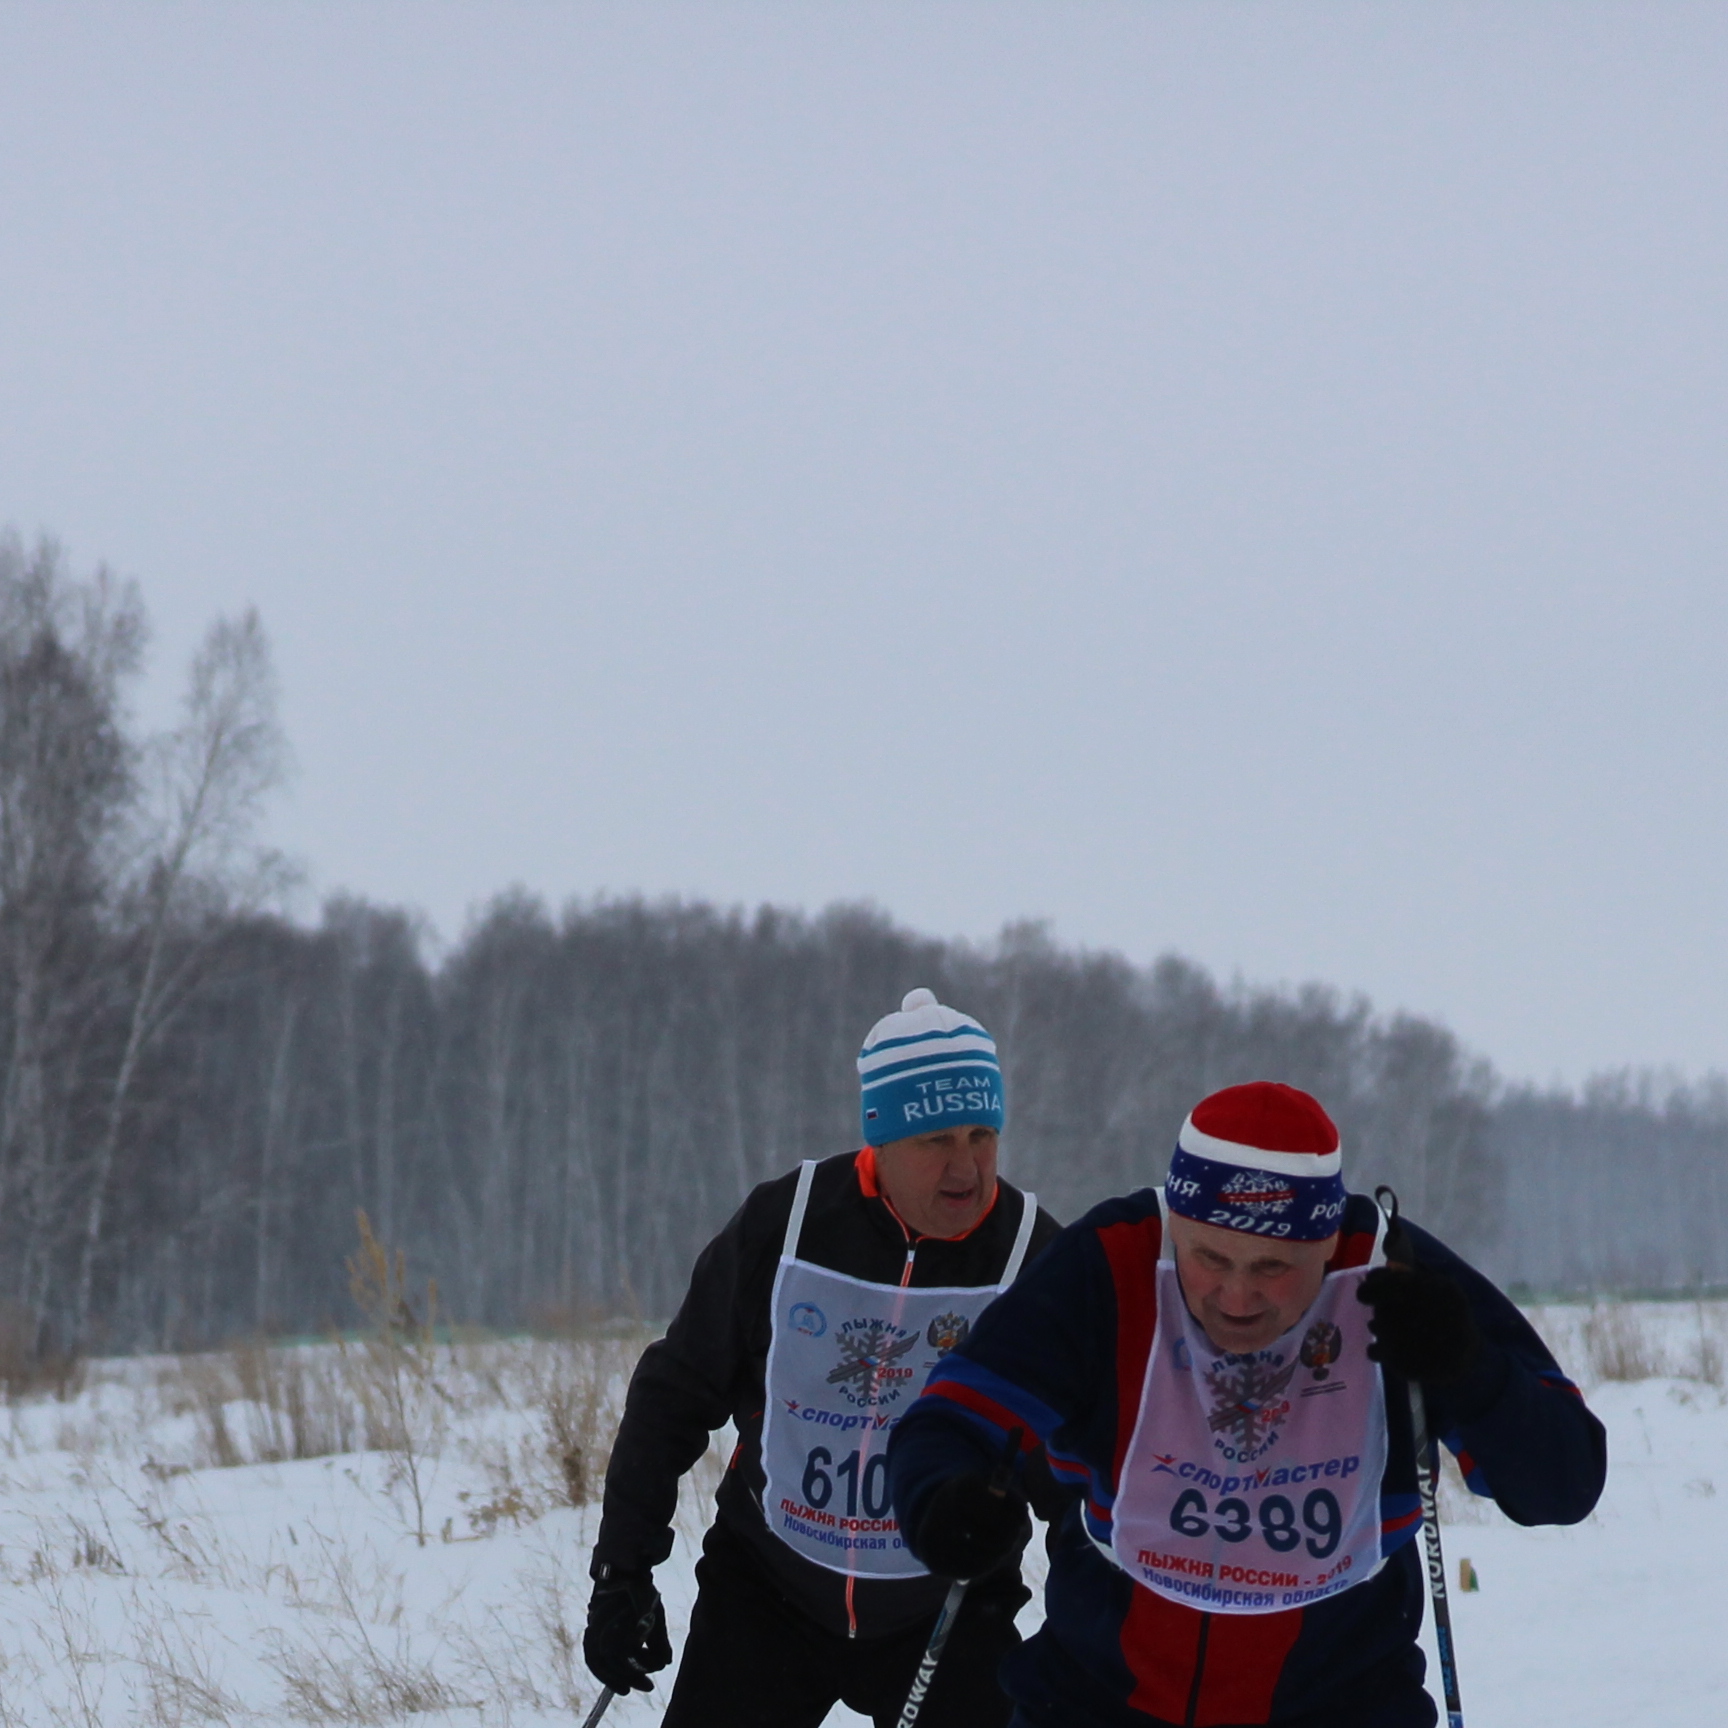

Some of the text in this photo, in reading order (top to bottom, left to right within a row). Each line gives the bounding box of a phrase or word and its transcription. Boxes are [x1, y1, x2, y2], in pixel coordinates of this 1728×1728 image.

[916, 1076, 991, 1095] TEAM
[903, 1091, 1001, 1122] RUSSIA
[1207, 1209, 1292, 1237] 2019
[840, 1317, 908, 1339] ЛЫЖНЯ
[877, 1366, 913, 1380] 2019
[838, 1384, 901, 1409] РОССИИ
[780, 1498, 836, 1528] ЛЫЖНЯ
[1169, 1488, 1343, 1559] 6389
[783, 1513, 887, 1551] Новосибирская
[1416, 1463, 1447, 1599] NORDWAY
[1137, 1549, 1214, 1578] ЛЫЖНЯ
[1218, 1564, 1299, 1587] РОССИИ
[1143, 1567, 1275, 1608] Новосибирская
